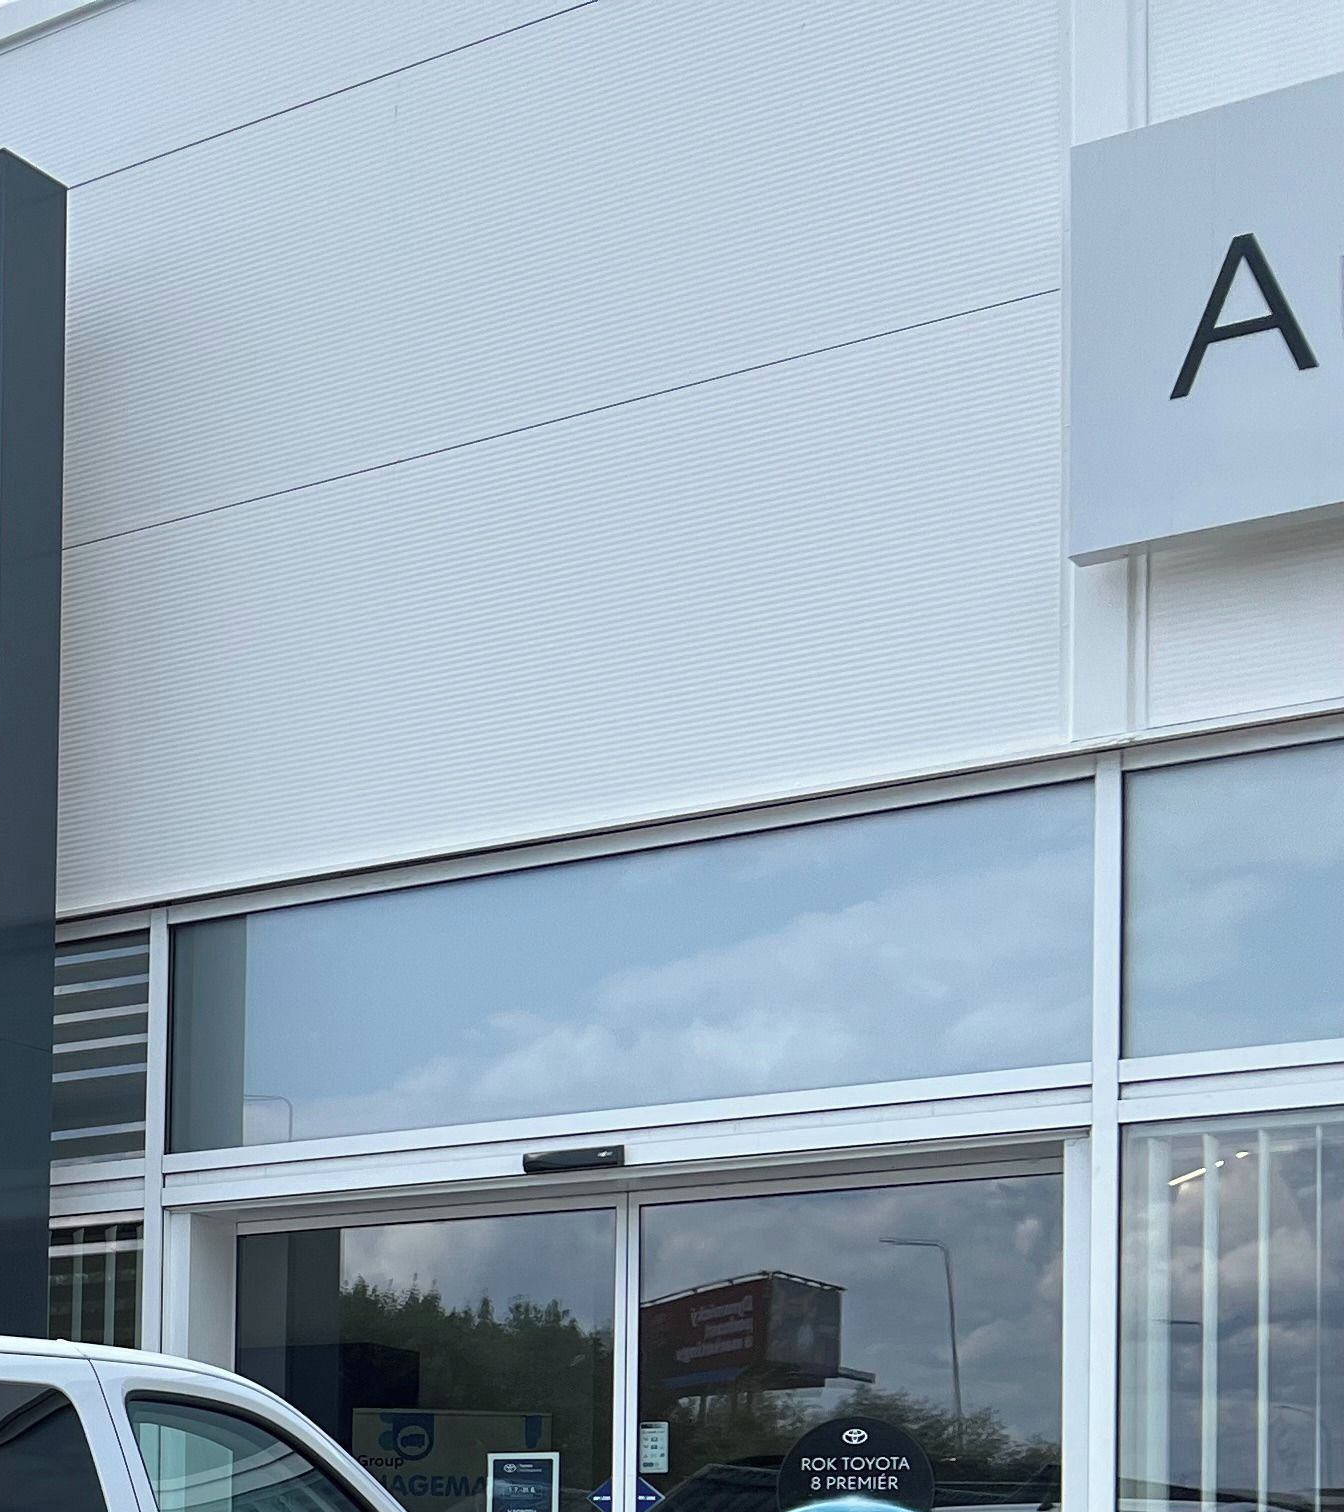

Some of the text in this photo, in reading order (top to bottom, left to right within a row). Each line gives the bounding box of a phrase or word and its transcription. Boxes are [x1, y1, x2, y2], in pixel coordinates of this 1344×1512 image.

[1169, 232, 1344, 400] A
[357, 1454, 405, 1470] Group
[800, 1456, 911, 1472] ROK TOYOTA
[381, 1474, 487, 1497] AGEMA
[810, 1473, 899, 1490] 8 PREMIÉR
